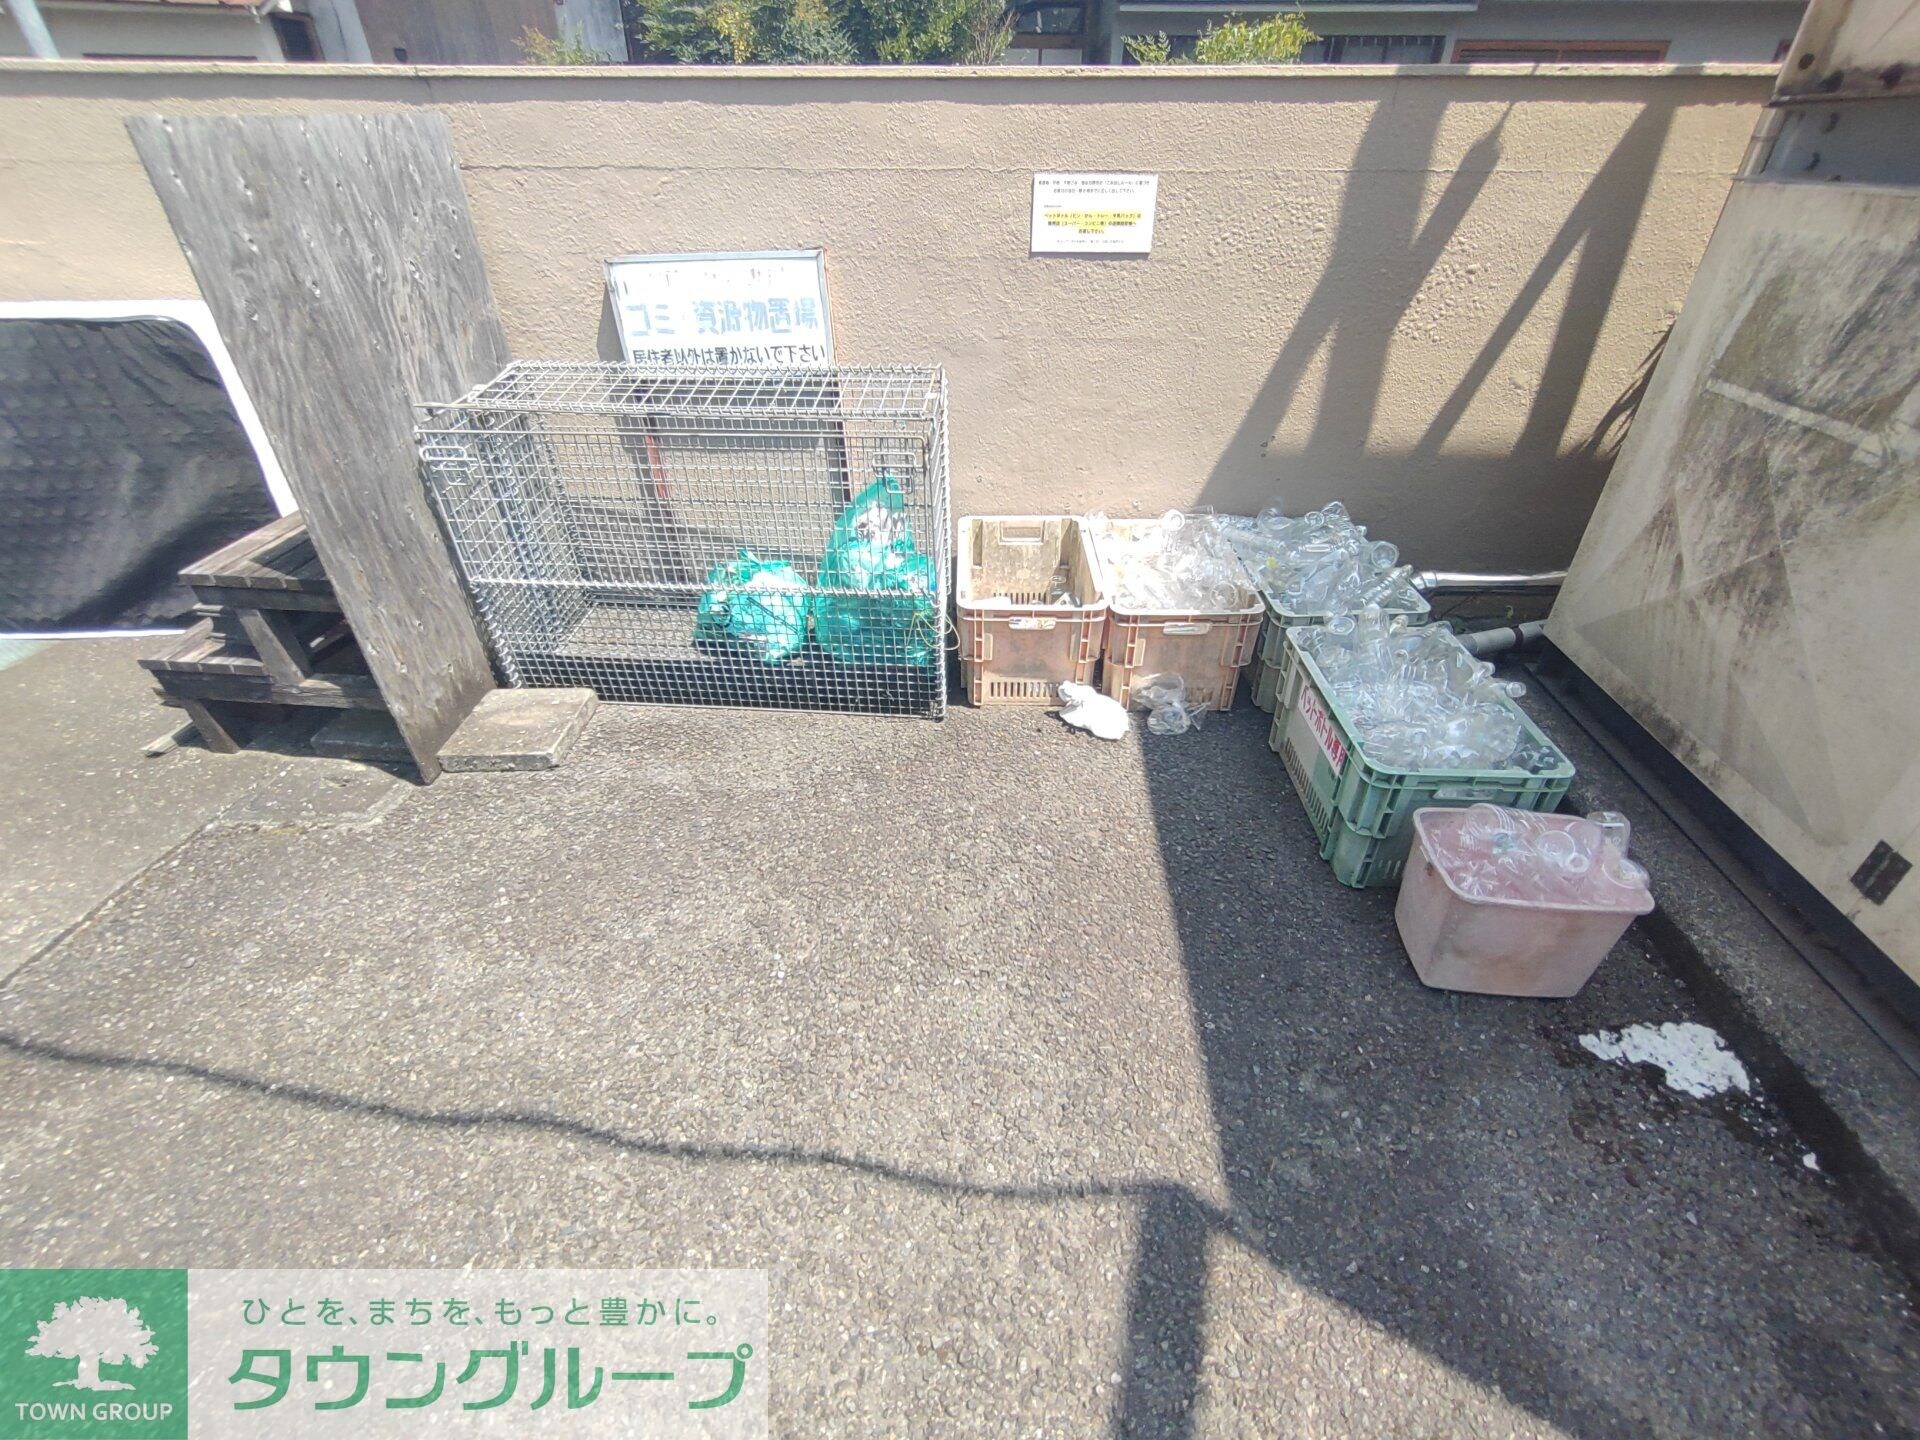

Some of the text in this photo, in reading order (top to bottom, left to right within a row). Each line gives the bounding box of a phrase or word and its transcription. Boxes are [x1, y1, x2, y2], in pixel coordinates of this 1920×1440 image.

[692, 297, 819, 336] 資源物置場
[632, 344, 827, 366] 居住者以外は置かないで下さい
